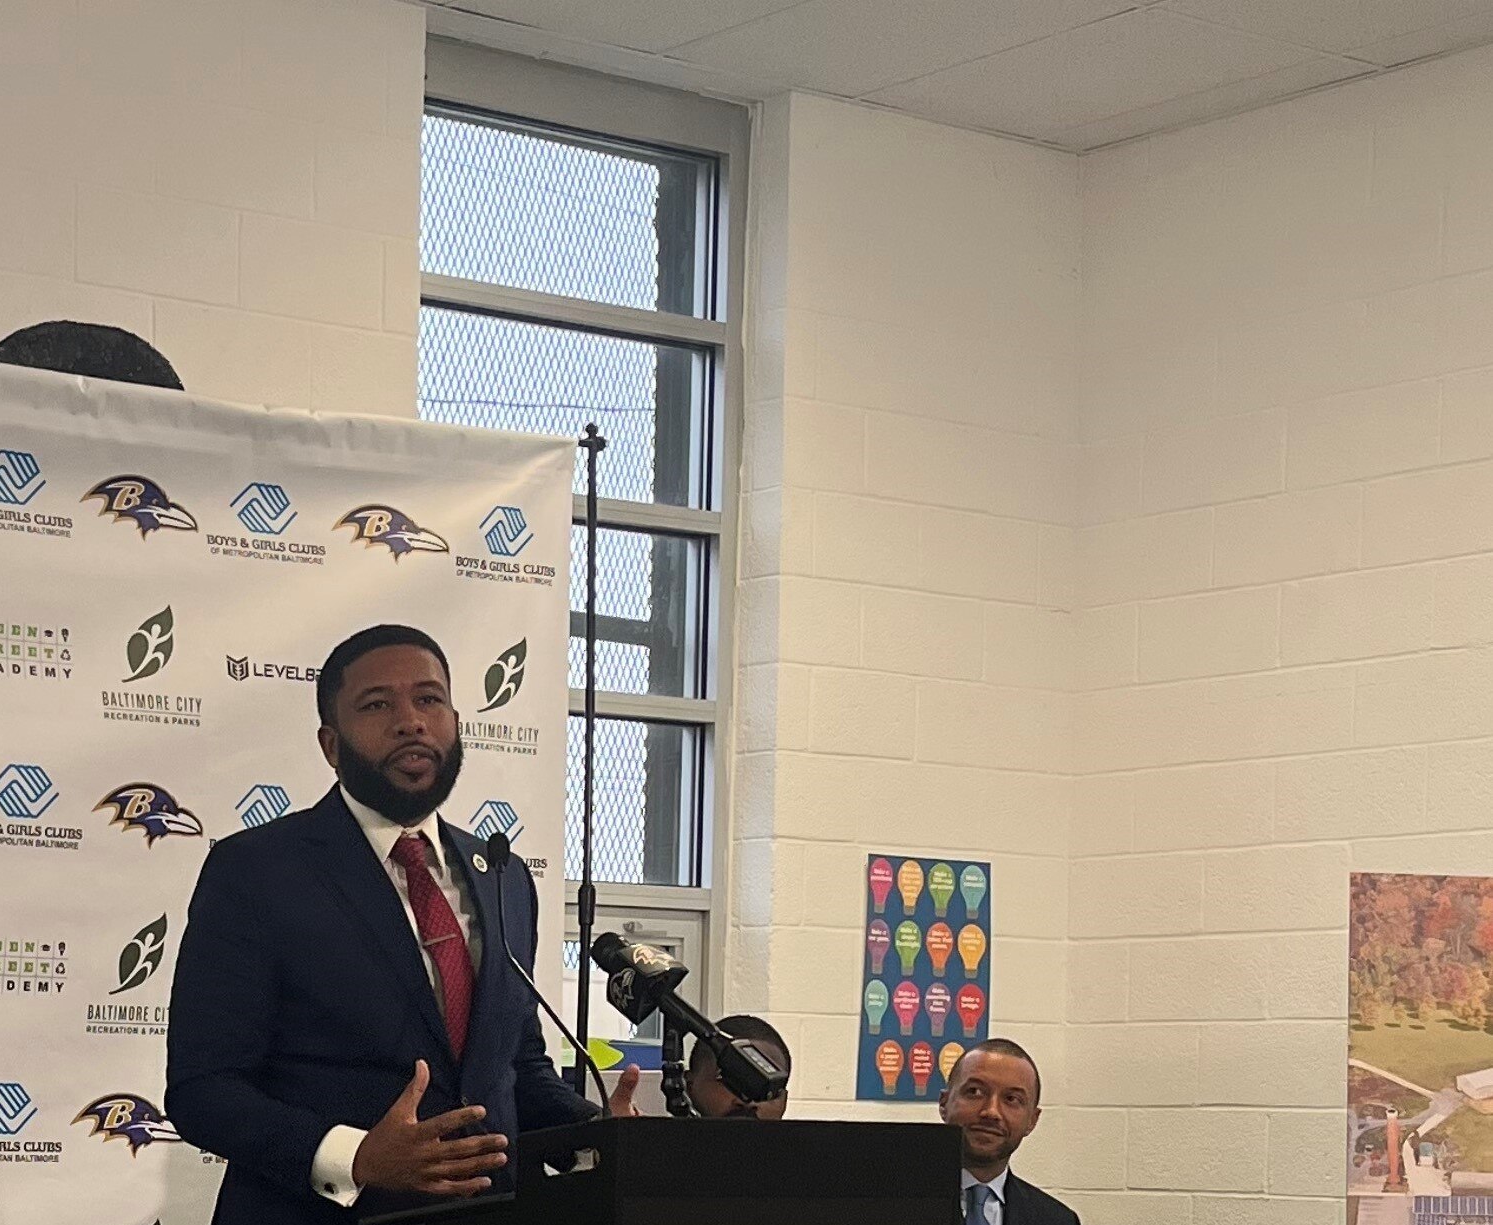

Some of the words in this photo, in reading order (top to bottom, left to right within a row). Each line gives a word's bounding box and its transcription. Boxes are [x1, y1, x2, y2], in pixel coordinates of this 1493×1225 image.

[34, 513, 72, 528] CLUBS
[207, 535, 237, 548] BOYS
[240, 538, 249, 549] &
[252, 539, 285, 552] GIRLS
[289, 543, 325, 556] CLUBS
[456, 557, 478, 570] BOYS
[480, 559, 487, 570] &
[490, 561, 519, 573] GIRLS
[524, 564, 555, 577] CLUBS
[103, 691, 170, 710] BALTIMORE
[176, 697, 202, 713] CITY
[518, 728, 539, 742] CITY
[7, 824, 41, 837] GIRLS
[45, 826, 82, 840] CLUBS
[35, 839, 78, 850] BALTIMORE
[88, 1005, 149, 1022] BALTIMORE
[86, 1025, 138, 1035] RECREATION
[24, 1141, 61, 1152] CLUBS
